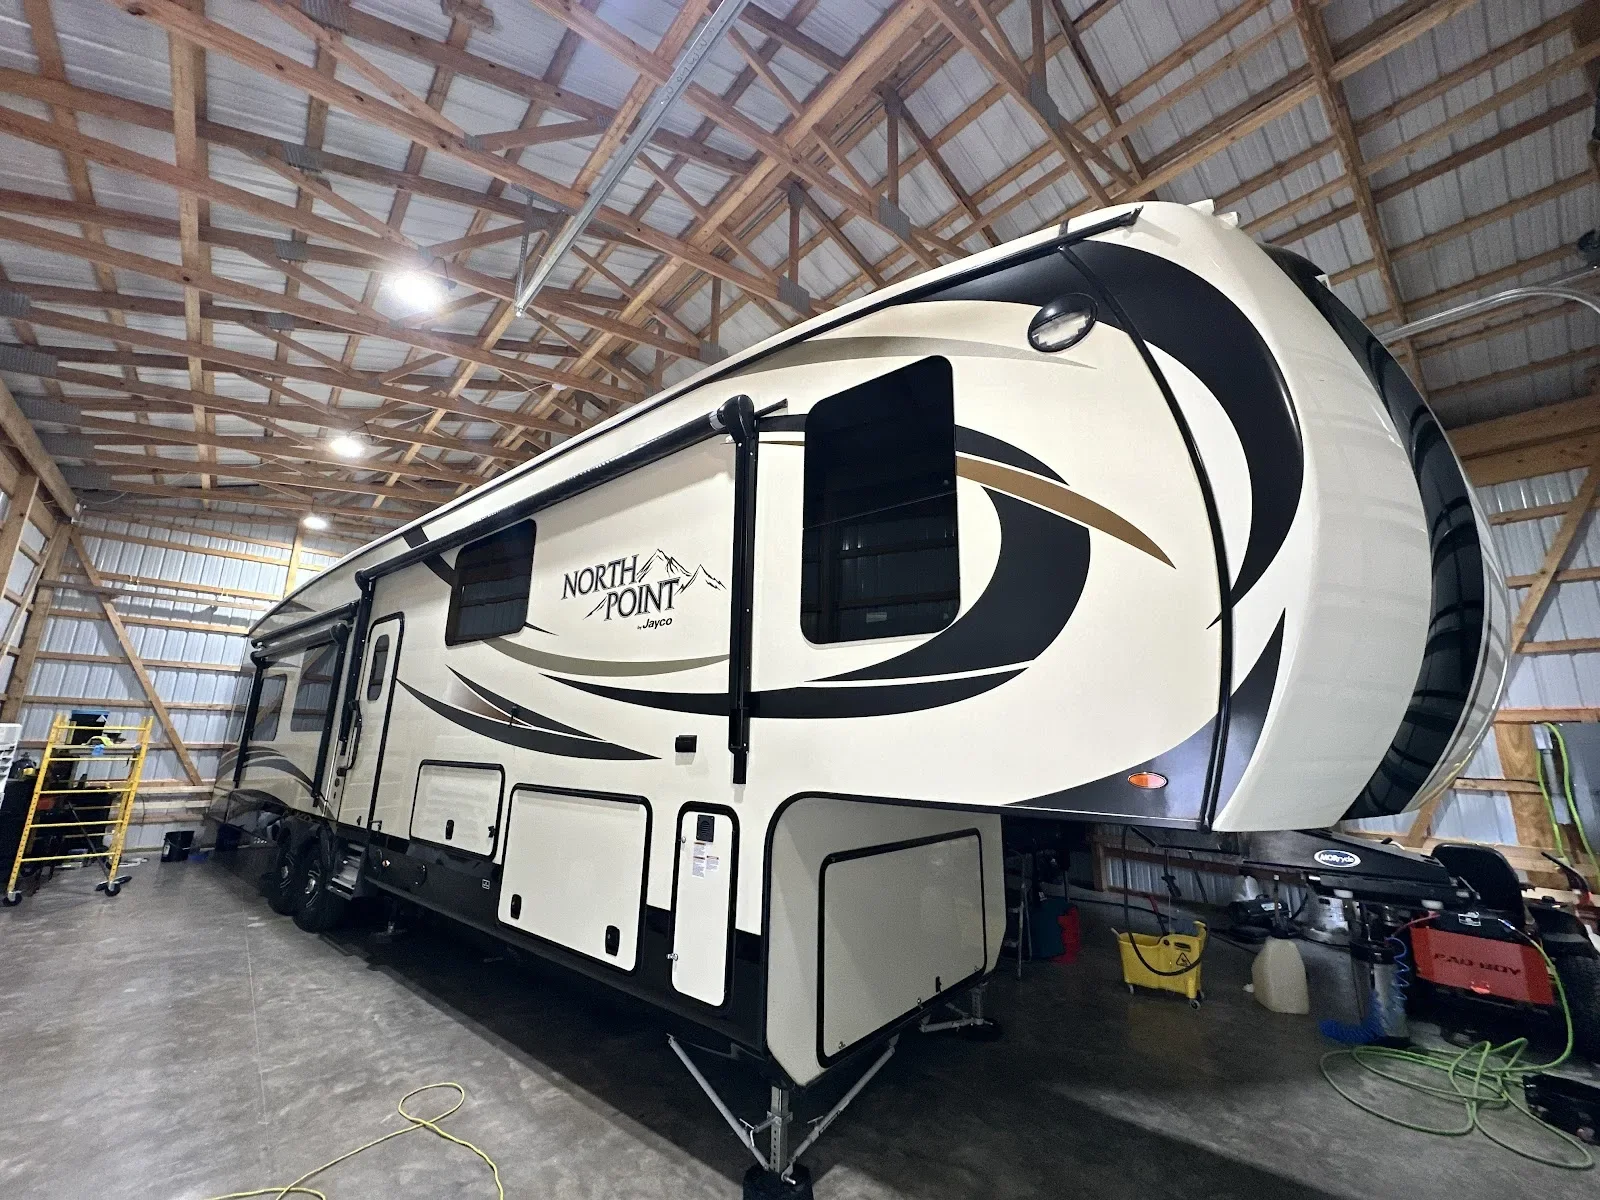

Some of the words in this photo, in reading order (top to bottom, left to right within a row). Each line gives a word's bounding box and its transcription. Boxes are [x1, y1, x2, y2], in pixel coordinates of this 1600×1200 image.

[561, 554, 639, 600] NORTH
[604, 576, 681, 621] POINT
[642, 617, 673, 630] Jayco
